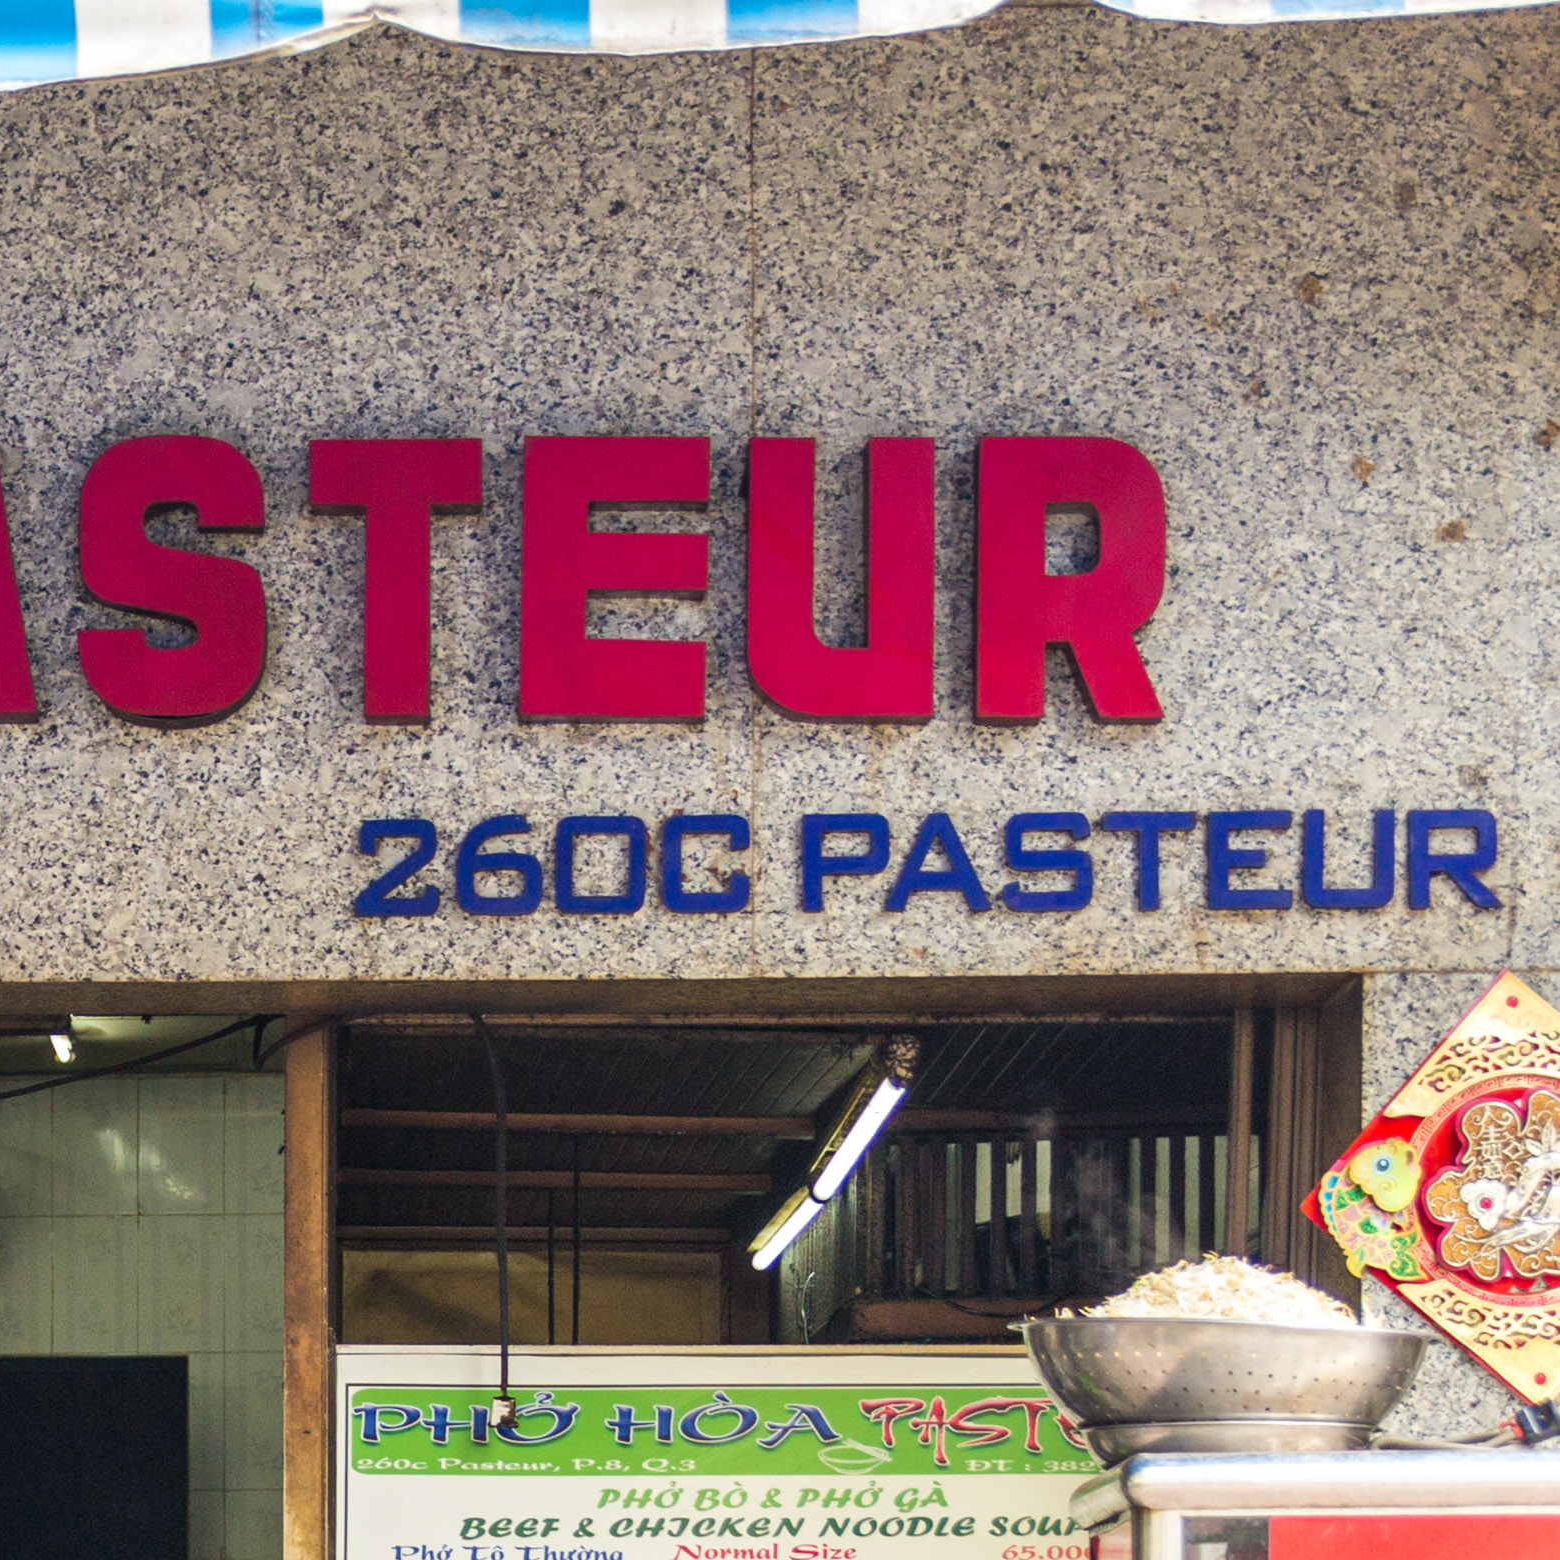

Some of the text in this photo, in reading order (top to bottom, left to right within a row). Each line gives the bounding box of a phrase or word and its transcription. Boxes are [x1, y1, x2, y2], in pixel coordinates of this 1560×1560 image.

[361, 808, 1501, 916] 260C PASTEUR
[353, 1391, 580, 1445] PHỞ
[606, 1391, 840, 1449] HÒA
[597, 1480, 949, 1513] PHỞ BÒ PHỞ GÀ
[459, 1516, 976, 1541] BEEF CHICKEN NOODLE
[392, 1544, 453, 1560] Phở
[790, 1543, 856, 1560] Size
